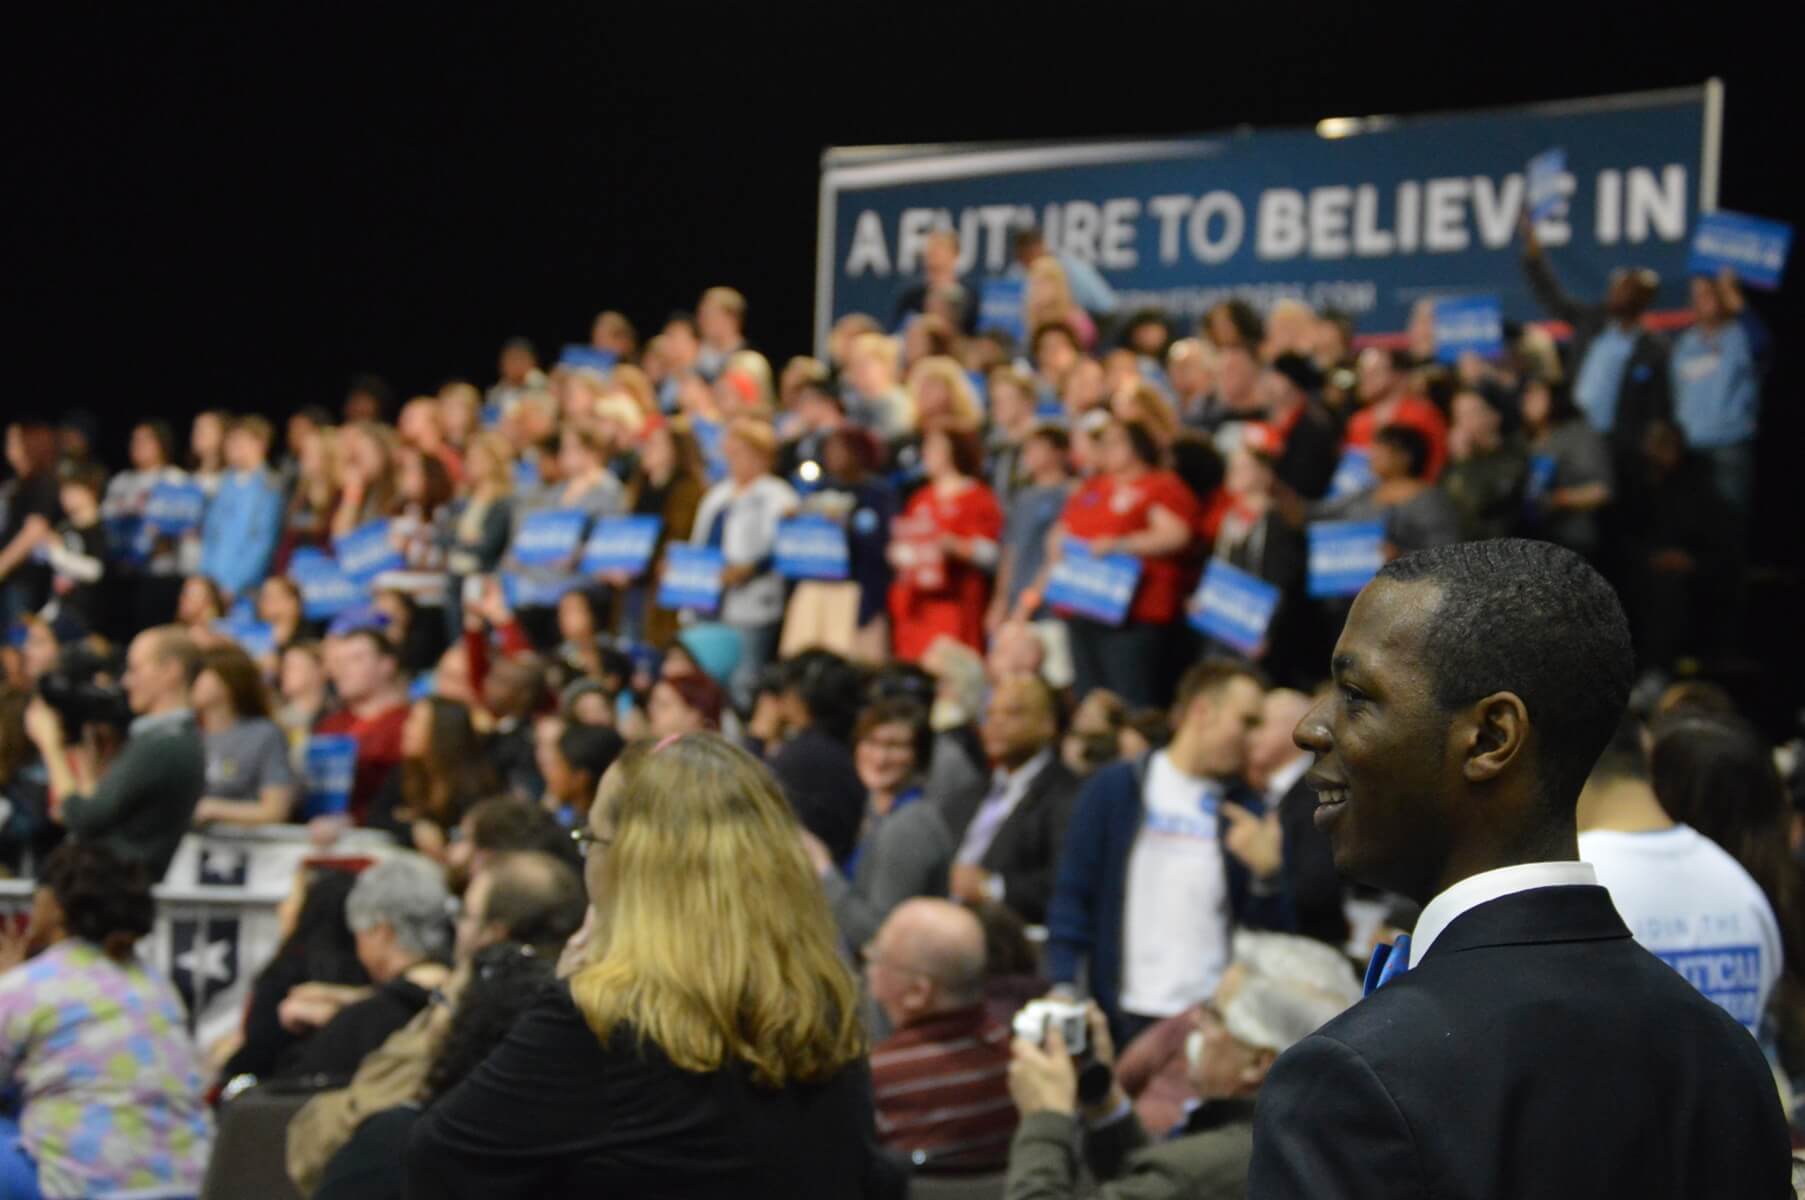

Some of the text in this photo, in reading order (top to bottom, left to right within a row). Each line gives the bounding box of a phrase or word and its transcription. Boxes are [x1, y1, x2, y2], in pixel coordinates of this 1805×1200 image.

[846, 208, 892, 278] A
[1148, 190, 1245, 264] TO
[1596, 164, 1686, 243] IN
